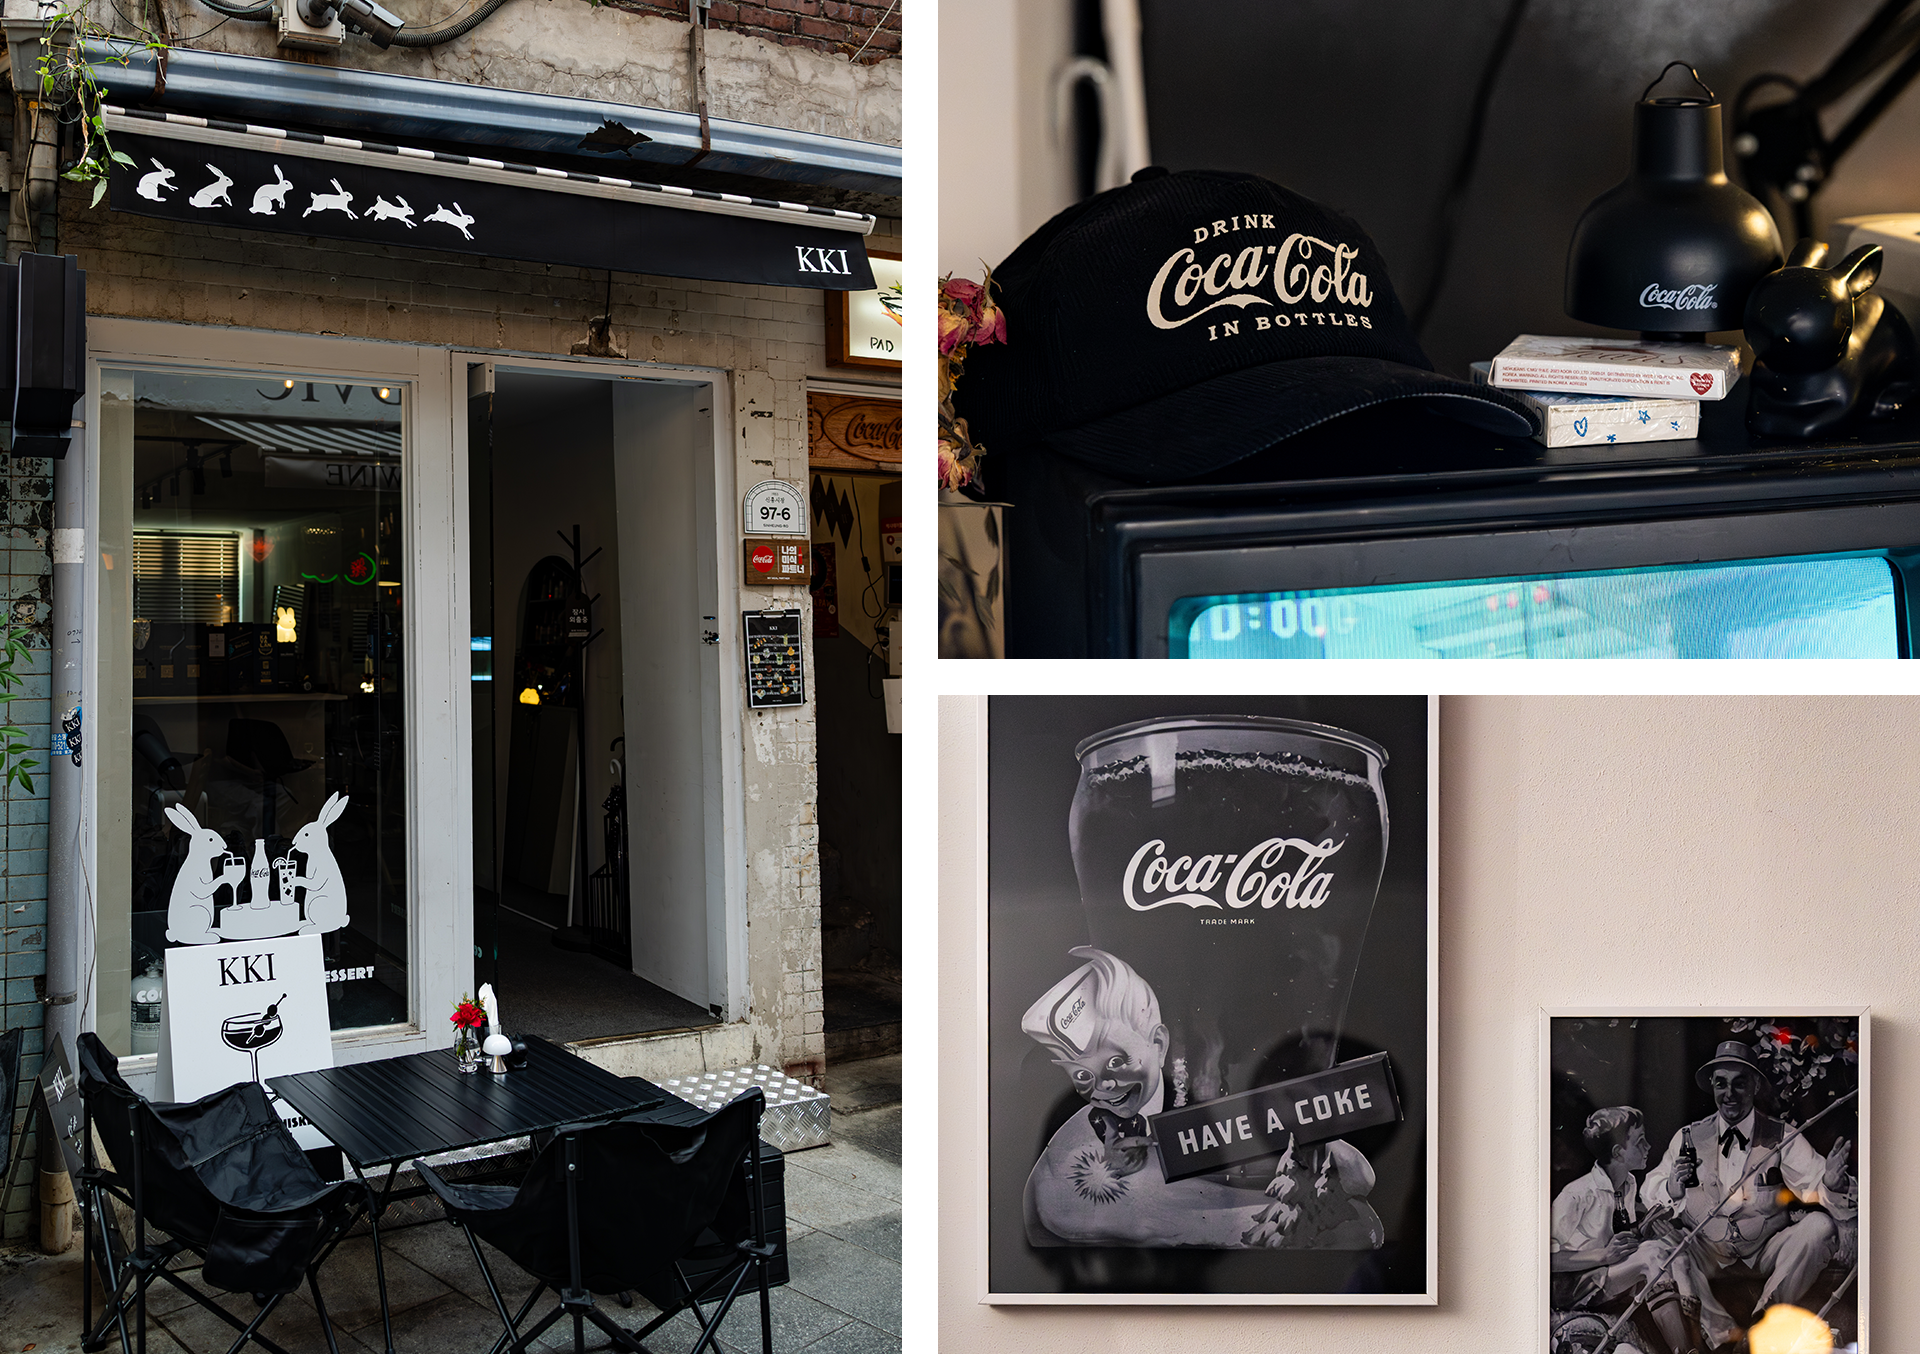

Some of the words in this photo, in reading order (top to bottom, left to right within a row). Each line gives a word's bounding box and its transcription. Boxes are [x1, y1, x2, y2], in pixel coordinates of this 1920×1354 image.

[1194, 214, 1276, 244] DRINK
[795, 246, 852, 275] KKI
[1146, 232, 1373, 330] Coca-Cola
[1208, 319, 1240, 341] IN
[1257, 311, 1373, 331] BOTTLES
[870, 336, 894, 353] PAD
[760, 506, 791, 521] 97-6
[781, 545, 797, 555] 나의
[781, 555, 797, 565] 미식
[572, 608, 585, 616] 잠시
[65, 717, 81, 732] KKI
[1123, 837, 1345, 912] Coca-Cola
[1200, 918, 1227, 926] TRADE
[1230, 918, 1256, 926] MARK
[217, 953, 277, 986] KKI
[1061, 996, 1086, 1029] Coca-Cola
[52, 1065, 67, 1102] KKI
[1177, 1115, 1253, 1155] HAVE
[1266, 1107, 1284, 1134] A
[1295, 1084, 1372, 1126] COKE
